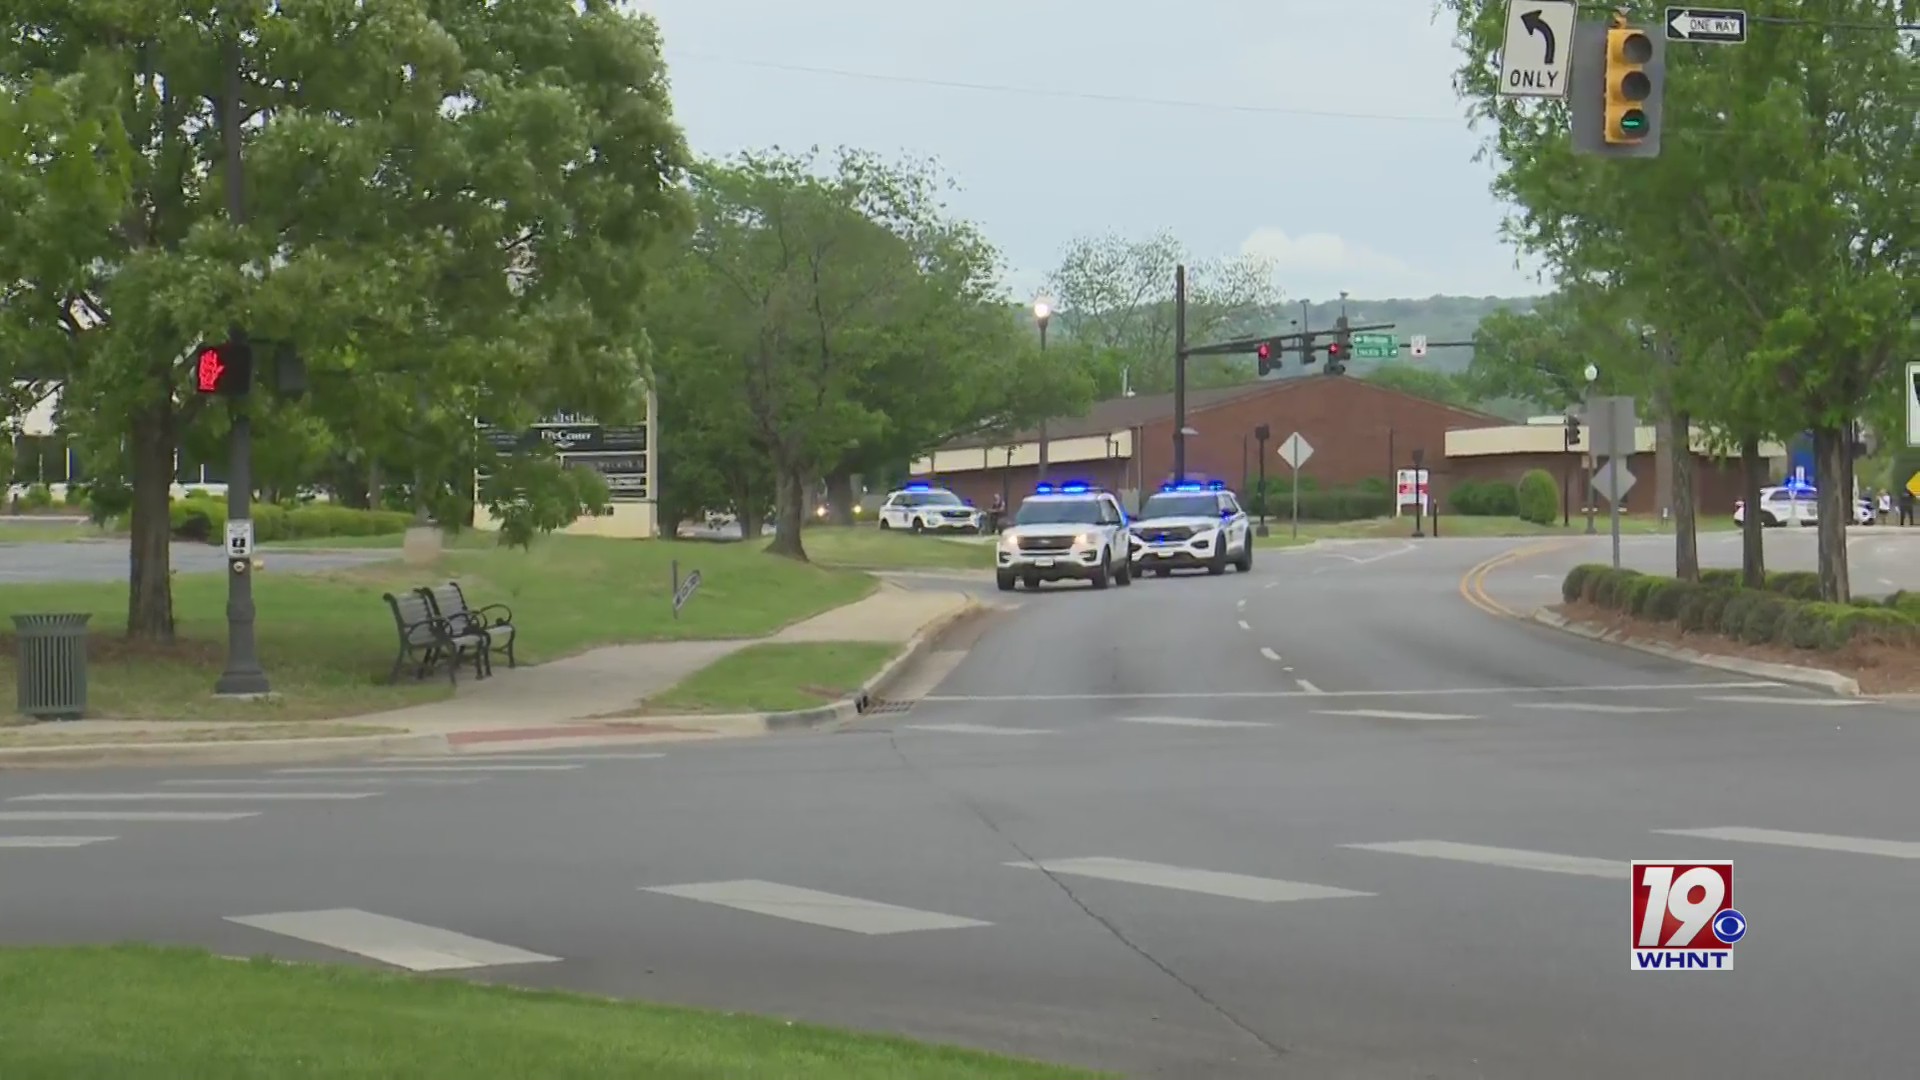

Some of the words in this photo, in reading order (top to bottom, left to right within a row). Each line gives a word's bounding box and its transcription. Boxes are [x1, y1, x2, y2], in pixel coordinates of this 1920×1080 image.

[1689, 19, 1711, 31] ONE
[1715, 20, 1738, 32] WAY
[1509, 69, 1560, 88] ONLY
